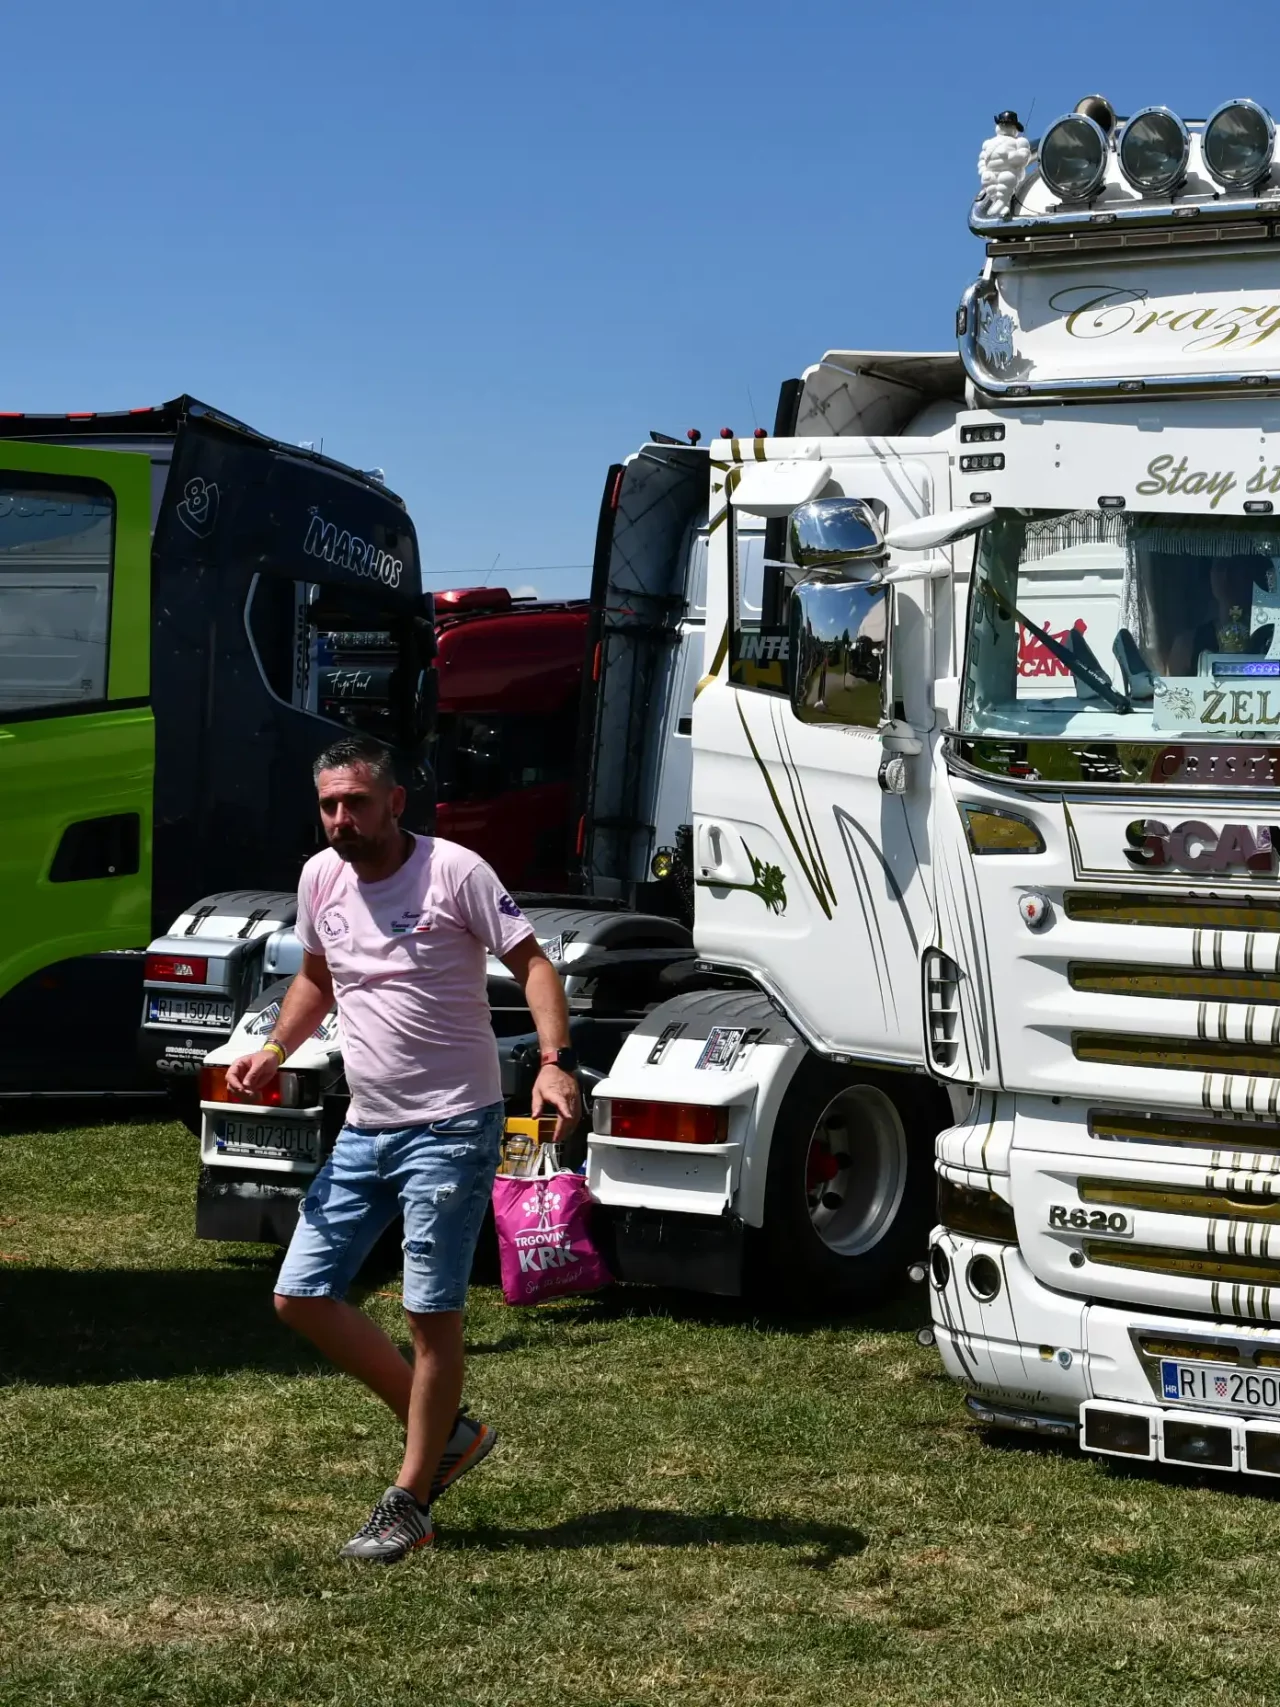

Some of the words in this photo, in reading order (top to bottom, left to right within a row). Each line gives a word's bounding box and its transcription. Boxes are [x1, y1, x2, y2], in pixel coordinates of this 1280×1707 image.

[1135, 453, 1238, 510] Stay
[303, 515, 403, 589] MARIJOS
[159, 1000, 173, 1018] RI
[227, 1122, 243, 1145] RI
[1049, 1204, 1128, 1233] R620
[518, 1240, 580, 1273] KRK
[1165, 1384, 1178, 1394] HR
[1180, 1367, 1207, 1399] RI
